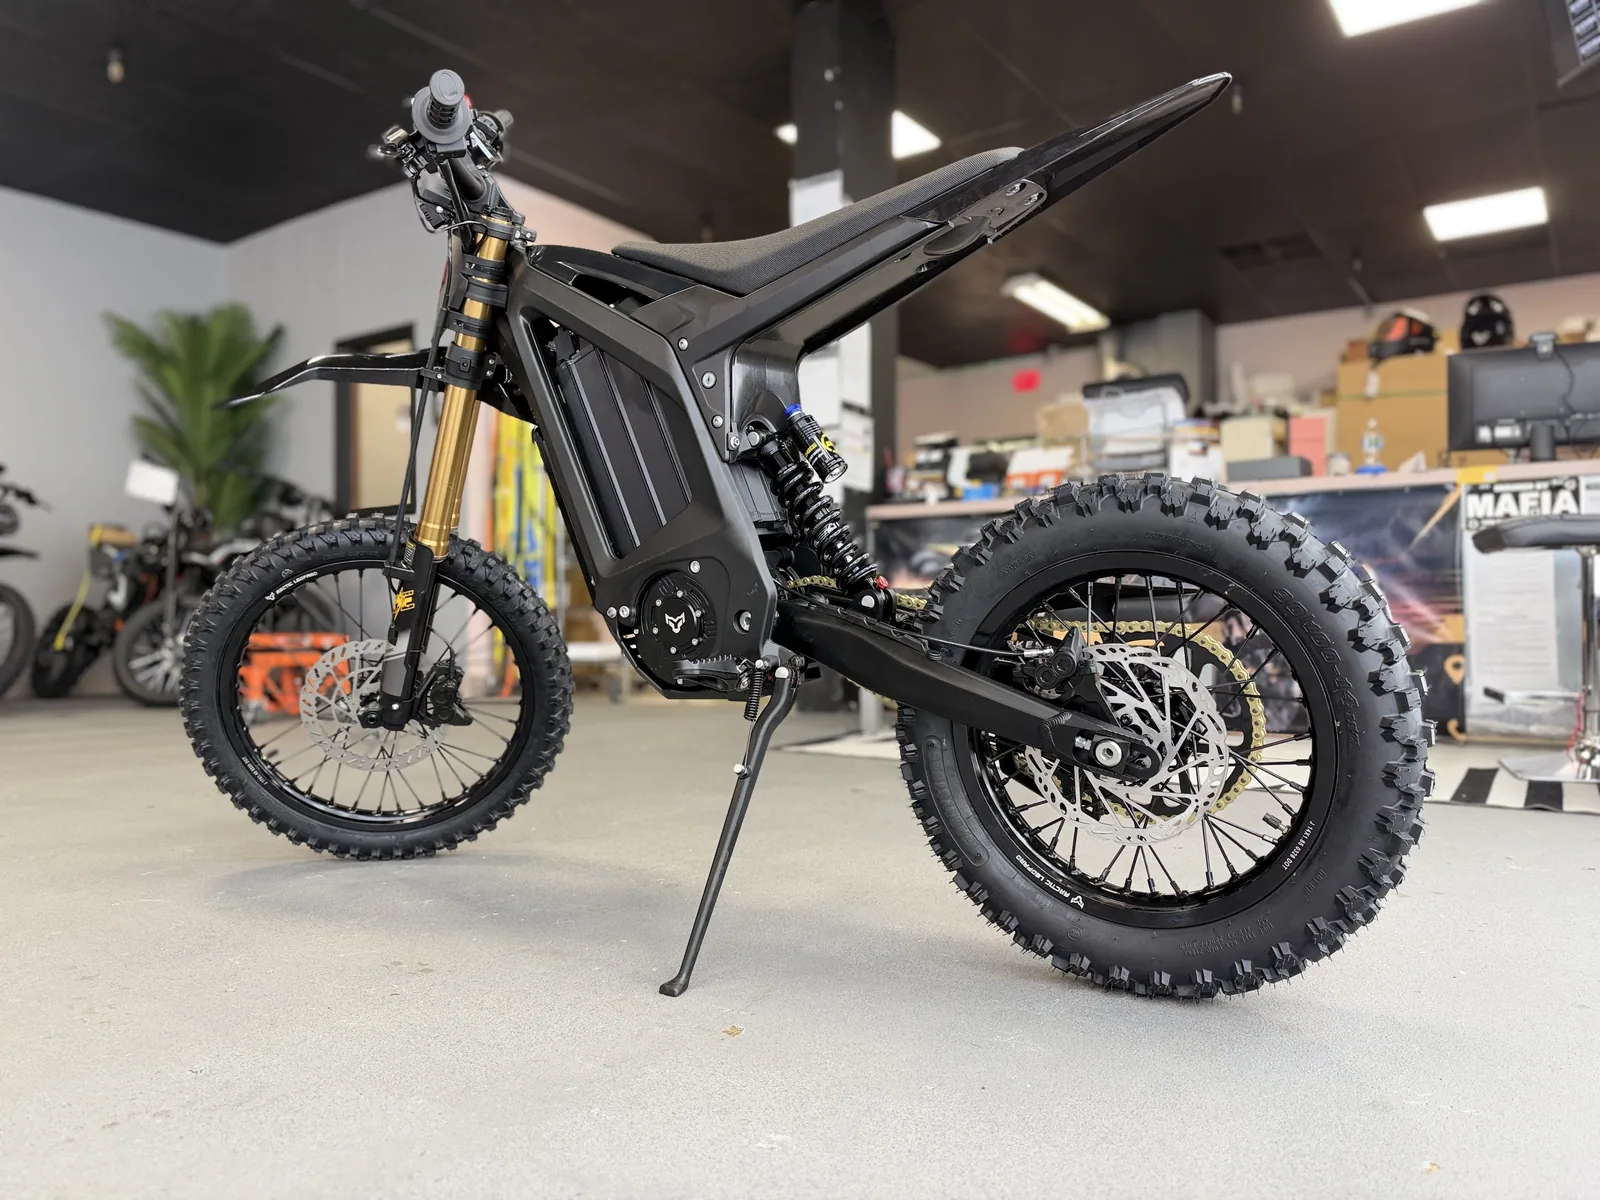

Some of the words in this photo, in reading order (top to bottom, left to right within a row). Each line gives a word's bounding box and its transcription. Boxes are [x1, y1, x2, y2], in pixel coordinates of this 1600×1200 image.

[1466, 488, 1579, 518] MAFIA
[275, 581, 294, 595] ARCTIC
[293, 571, 318, 584] LEOPARD
[1015, 854, 1045, 881] LEOPARD
[1281, 857, 1293, 871] DOT
[1044, 879, 1070, 898] ARCTIC
